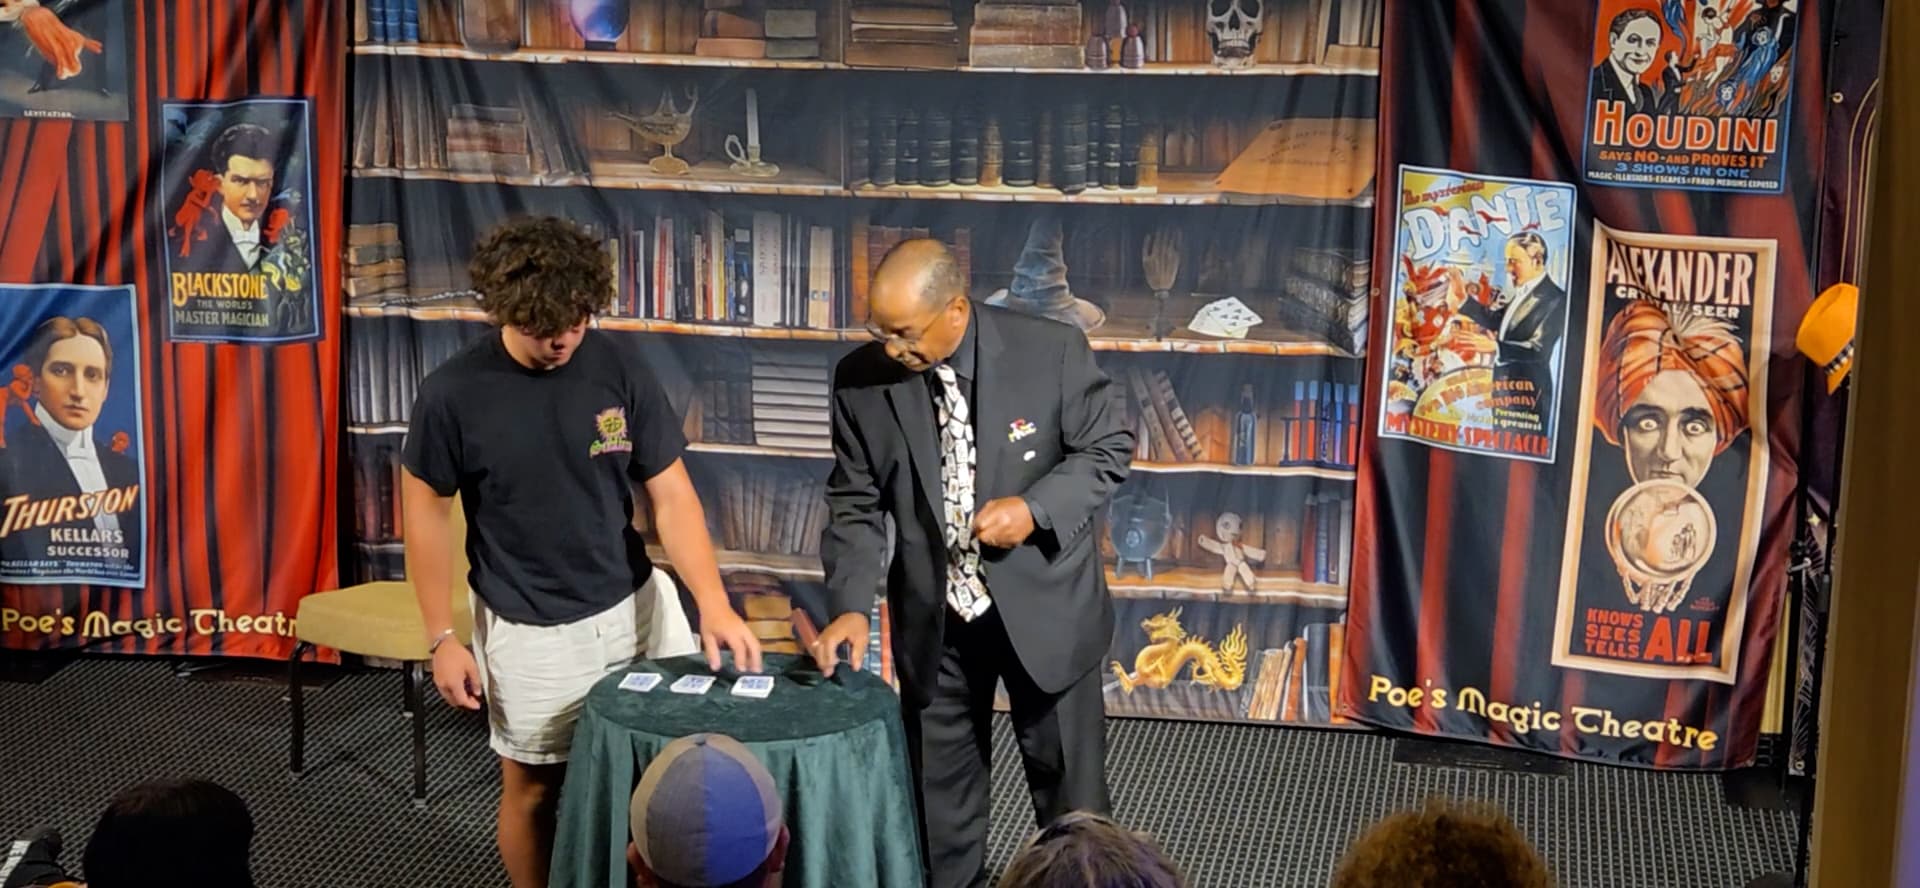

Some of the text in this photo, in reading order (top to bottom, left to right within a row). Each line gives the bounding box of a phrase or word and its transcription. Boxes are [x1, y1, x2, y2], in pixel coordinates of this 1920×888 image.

[1593, 99, 1778, 153] HOUDINI
[1600, 151, 1632, 162] SAYS
[1691, 153, 1747, 167] PROVES
[1750, 156, 1768, 169] IT
[1615, 163, 1750, 178] 3 SHOWS IN ONE
[1402, 185, 1566, 260] DANTE
[1607, 240, 1753, 305] ALEXANDER
[172, 271, 269, 307] BLACKSTONE
[198, 300, 213, 309] THE
[1615, 286, 1740, 319] CRAL SEER
[175, 311, 269, 327] MASTER MAGICIAN
[0, 484, 139, 538] THURSTON
[50, 528, 124, 543] KELLARS
[47, 545, 129, 558] SUCCESSOR
[1, 608, 75, 635] Poe's
[82, 610, 182, 639] Magic
[1587, 608, 1643, 627] KNOWS
[1586, 624, 1641, 642] SEES
[1643, 615, 1713, 664] ALL
[1585, 639, 1640, 658] TELLS
[1368, 675, 1719, 751] Poe's Magic Theatre
